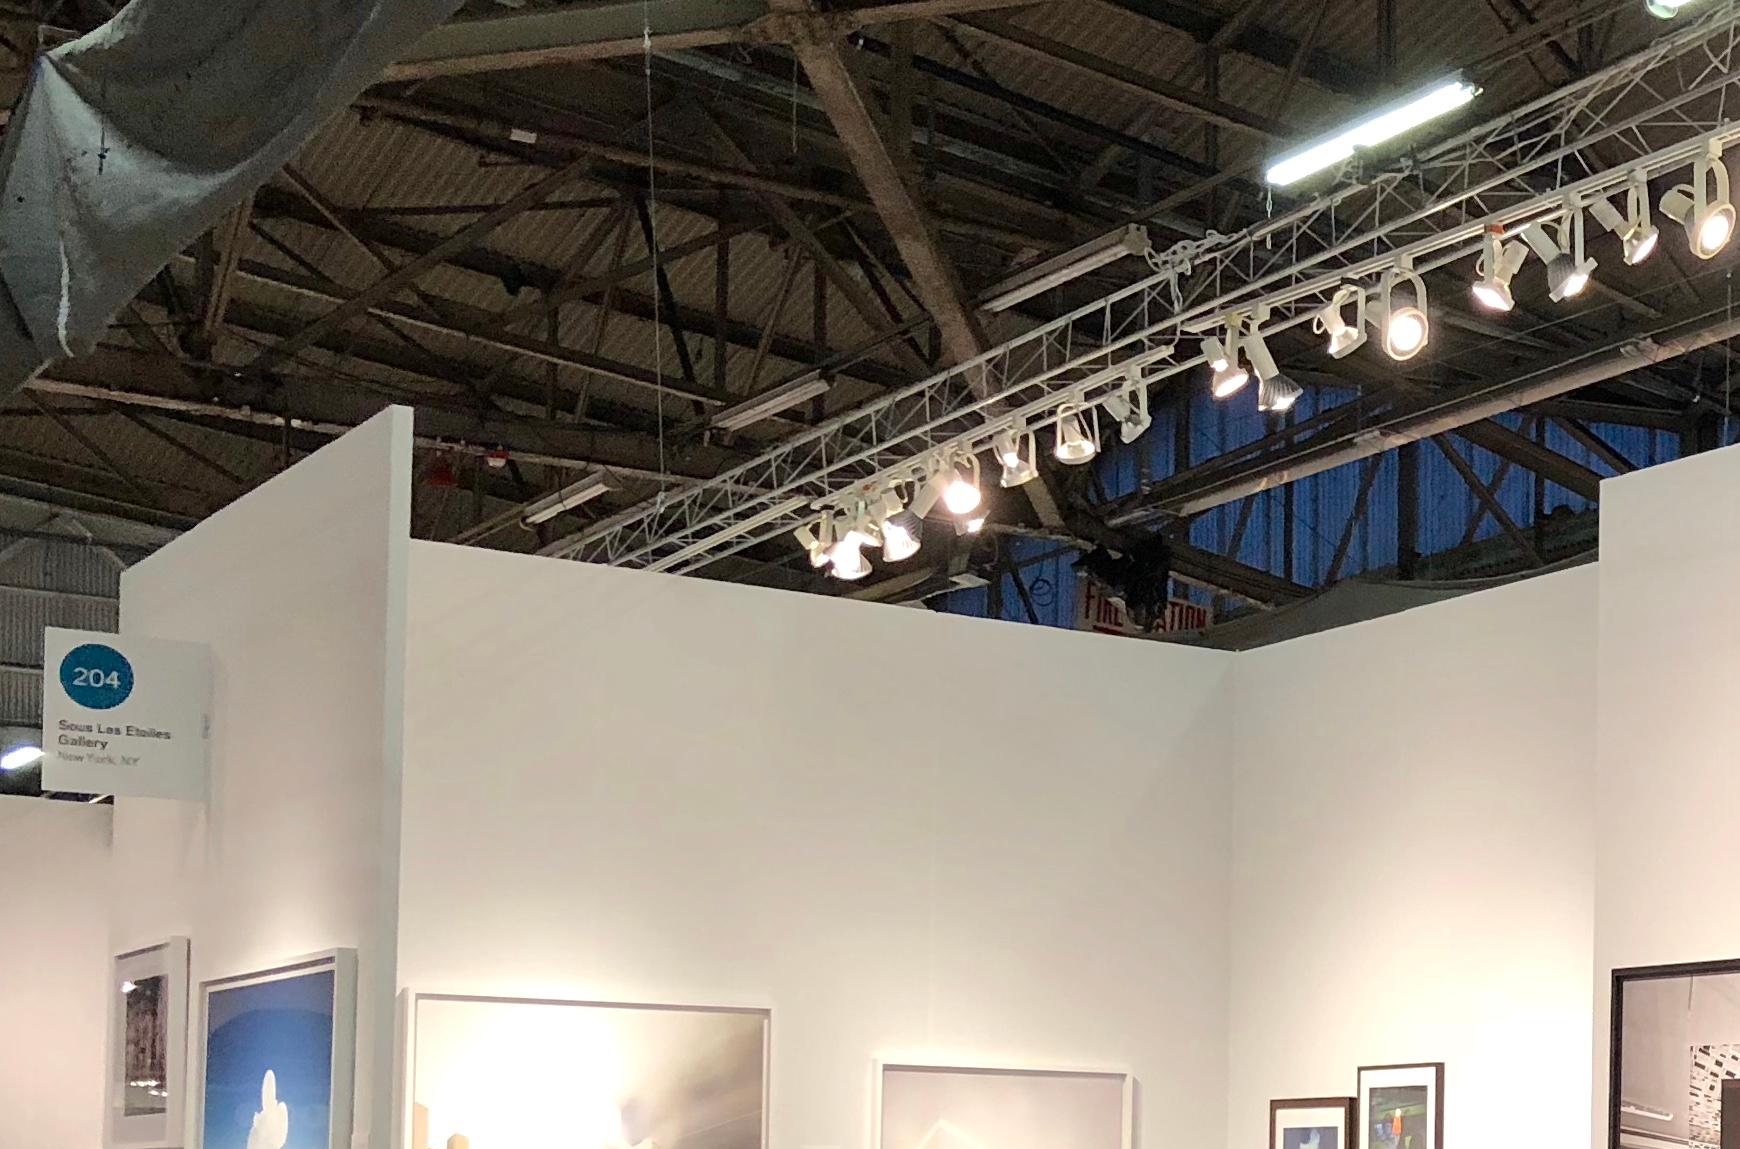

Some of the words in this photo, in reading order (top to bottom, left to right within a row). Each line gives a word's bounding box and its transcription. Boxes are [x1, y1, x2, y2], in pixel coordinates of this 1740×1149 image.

[72, 667, 120, 689] 204
[58, 719, 93, 733] Sous
[97, 723, 121, 736] Les
[126, 725, 172, 740] Etoiles
[58, 734, 109, 750] Gallery
[57, 751, 84, 763] New
